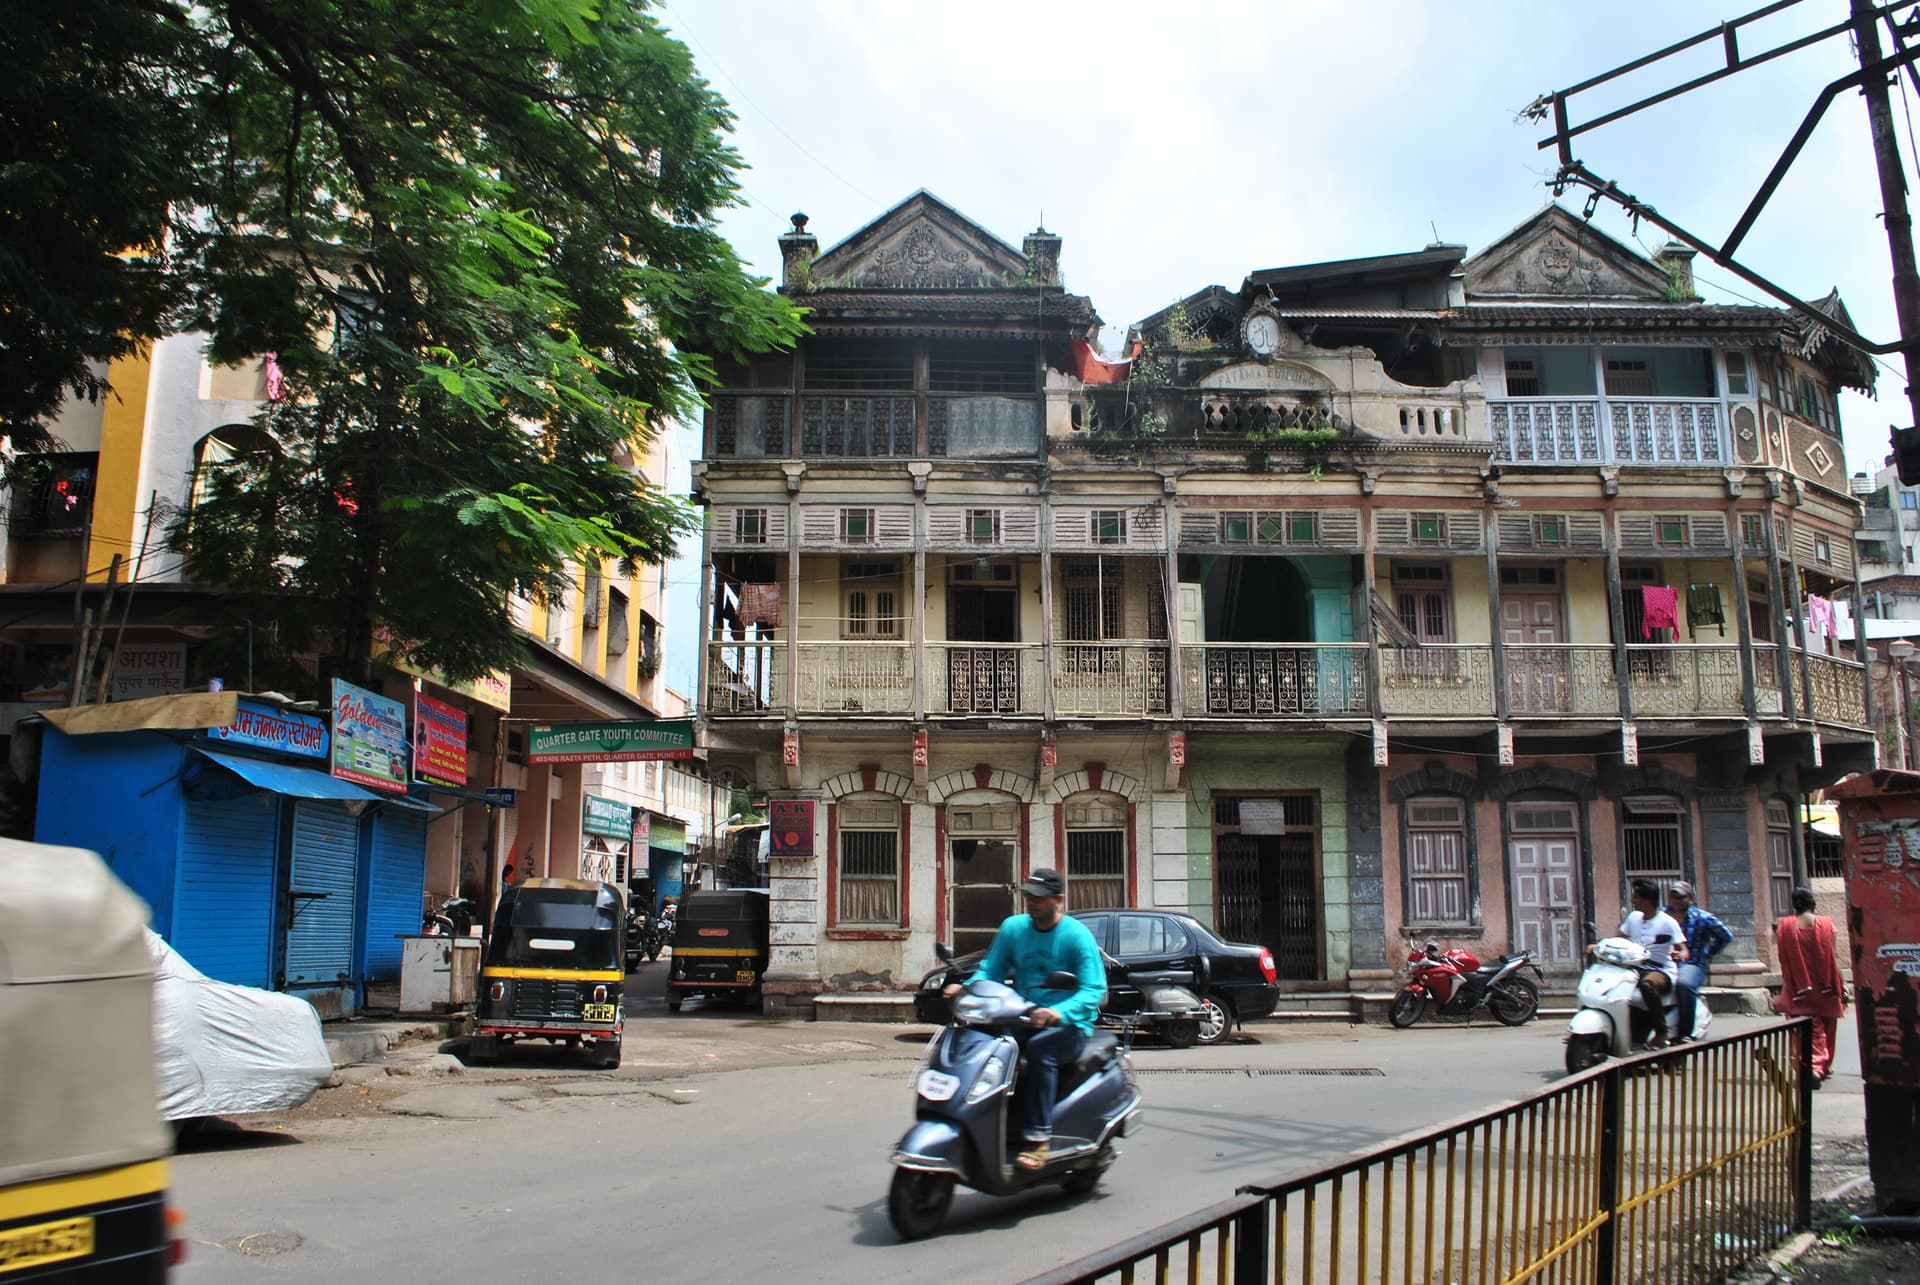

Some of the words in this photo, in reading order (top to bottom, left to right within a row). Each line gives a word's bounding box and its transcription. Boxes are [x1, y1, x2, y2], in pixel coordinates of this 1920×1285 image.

[119, 650, 182, 669] आयशा
[117, 677, 143, 693] सुपर
[338, 694, 380, 728] Golden
[252, 714, 289, 742] जनरल
[536, 732, 577, 749] QUARTER
[578, 730, 601, 742] GATE
[602, 729, 631, 740] YOUTH
[633, 729, 685, 745] COMMITTEE
[603, 753, 635, 761] QUARTER
[657, 752, 675, 760] PUNE
